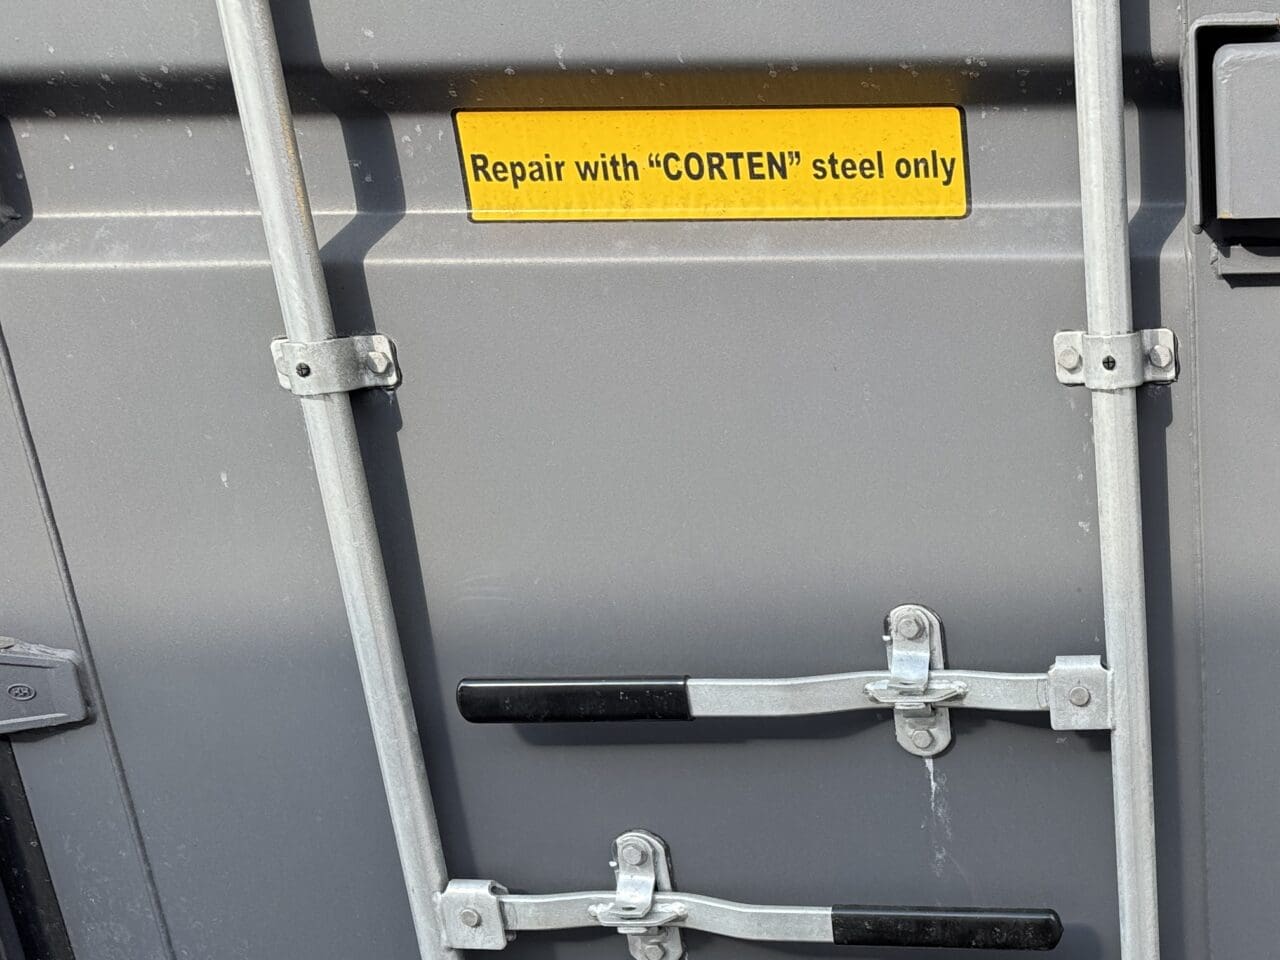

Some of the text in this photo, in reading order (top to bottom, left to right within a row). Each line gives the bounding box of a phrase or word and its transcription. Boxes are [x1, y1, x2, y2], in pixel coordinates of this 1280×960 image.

[471, 150, 956, 189] Repair with “CORTEN” steel only
